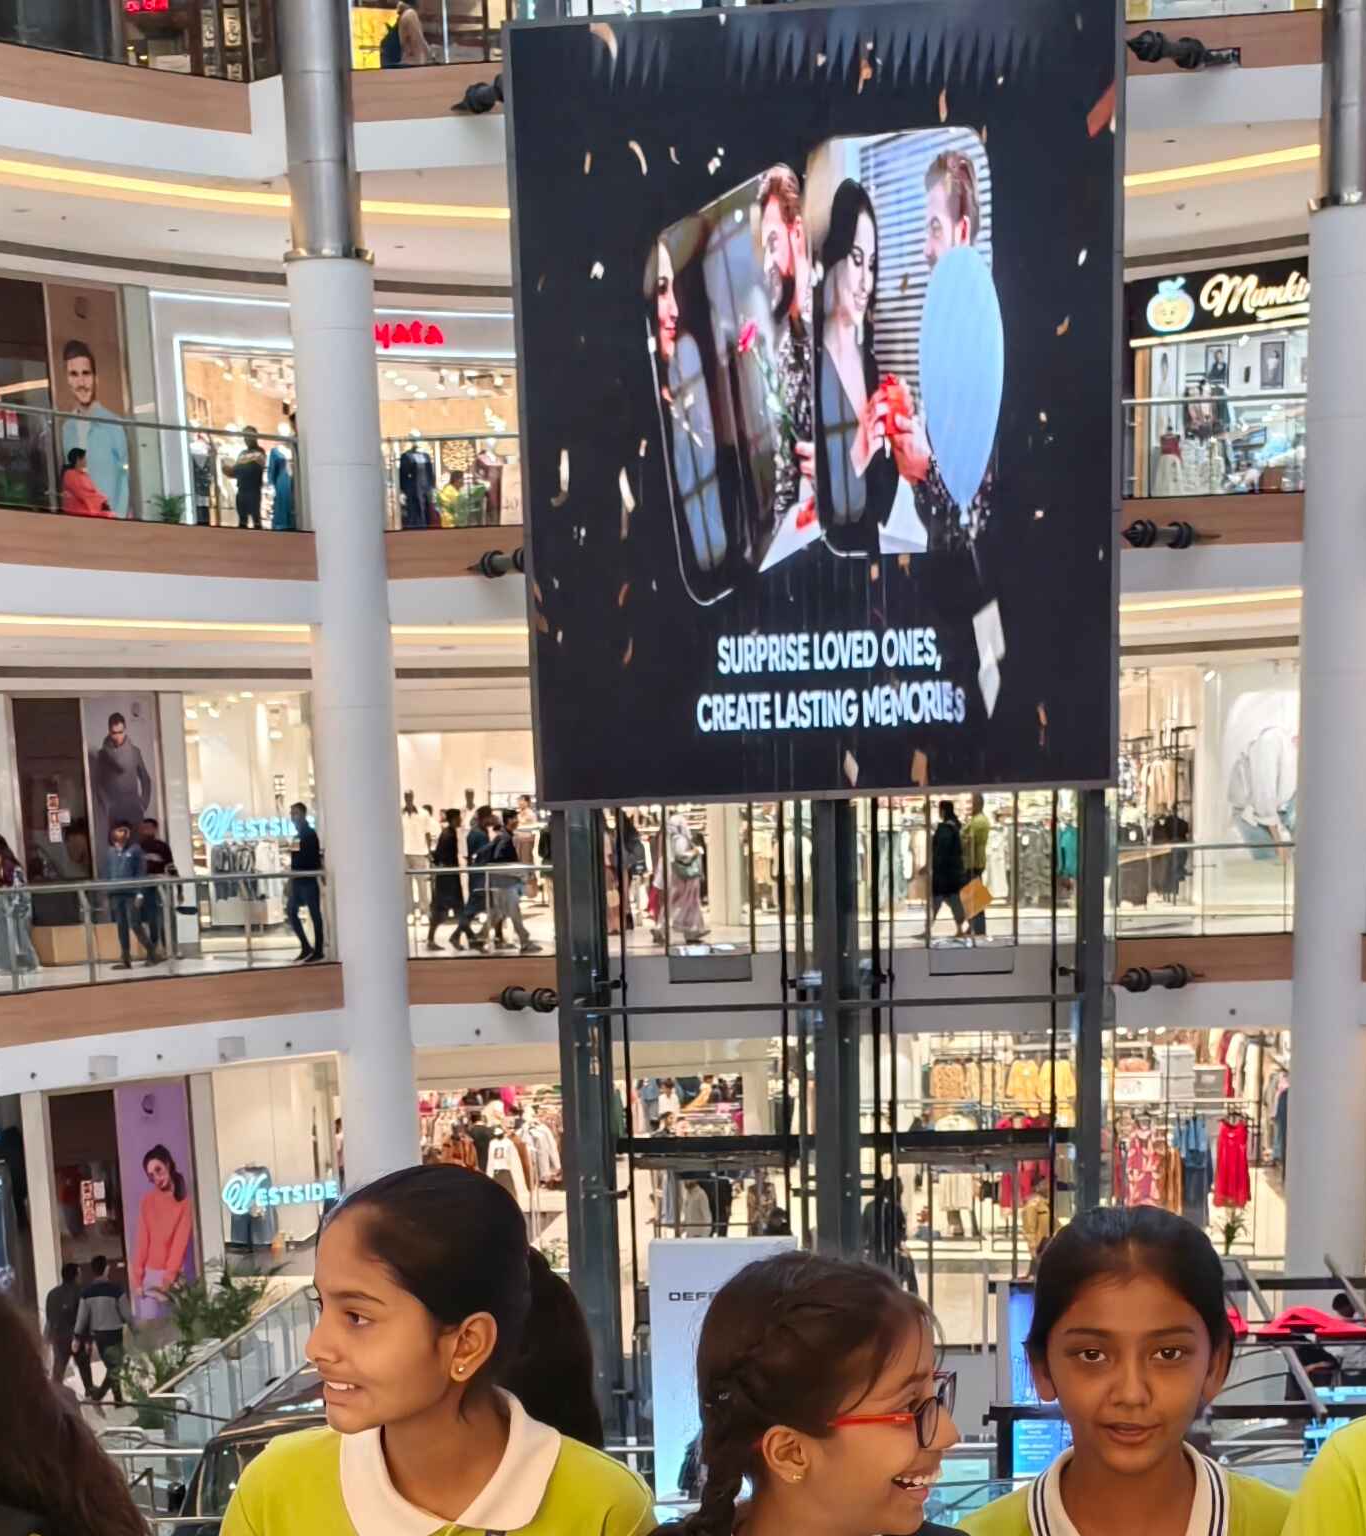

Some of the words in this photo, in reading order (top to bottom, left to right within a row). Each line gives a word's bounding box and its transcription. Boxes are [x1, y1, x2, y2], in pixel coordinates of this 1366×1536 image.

[717, 632, 810, 674] SURPRISE
[813, 629, 878, 671] LOVED
[882, 626, 942, 672] ONES,
[697, 692, 771, 733] CREATE
[775, 688, 859, 730] LASTING
[862, 680, 966, 728] MEMORIES
[222, 1173, 339, 1215] WESTSIDE
